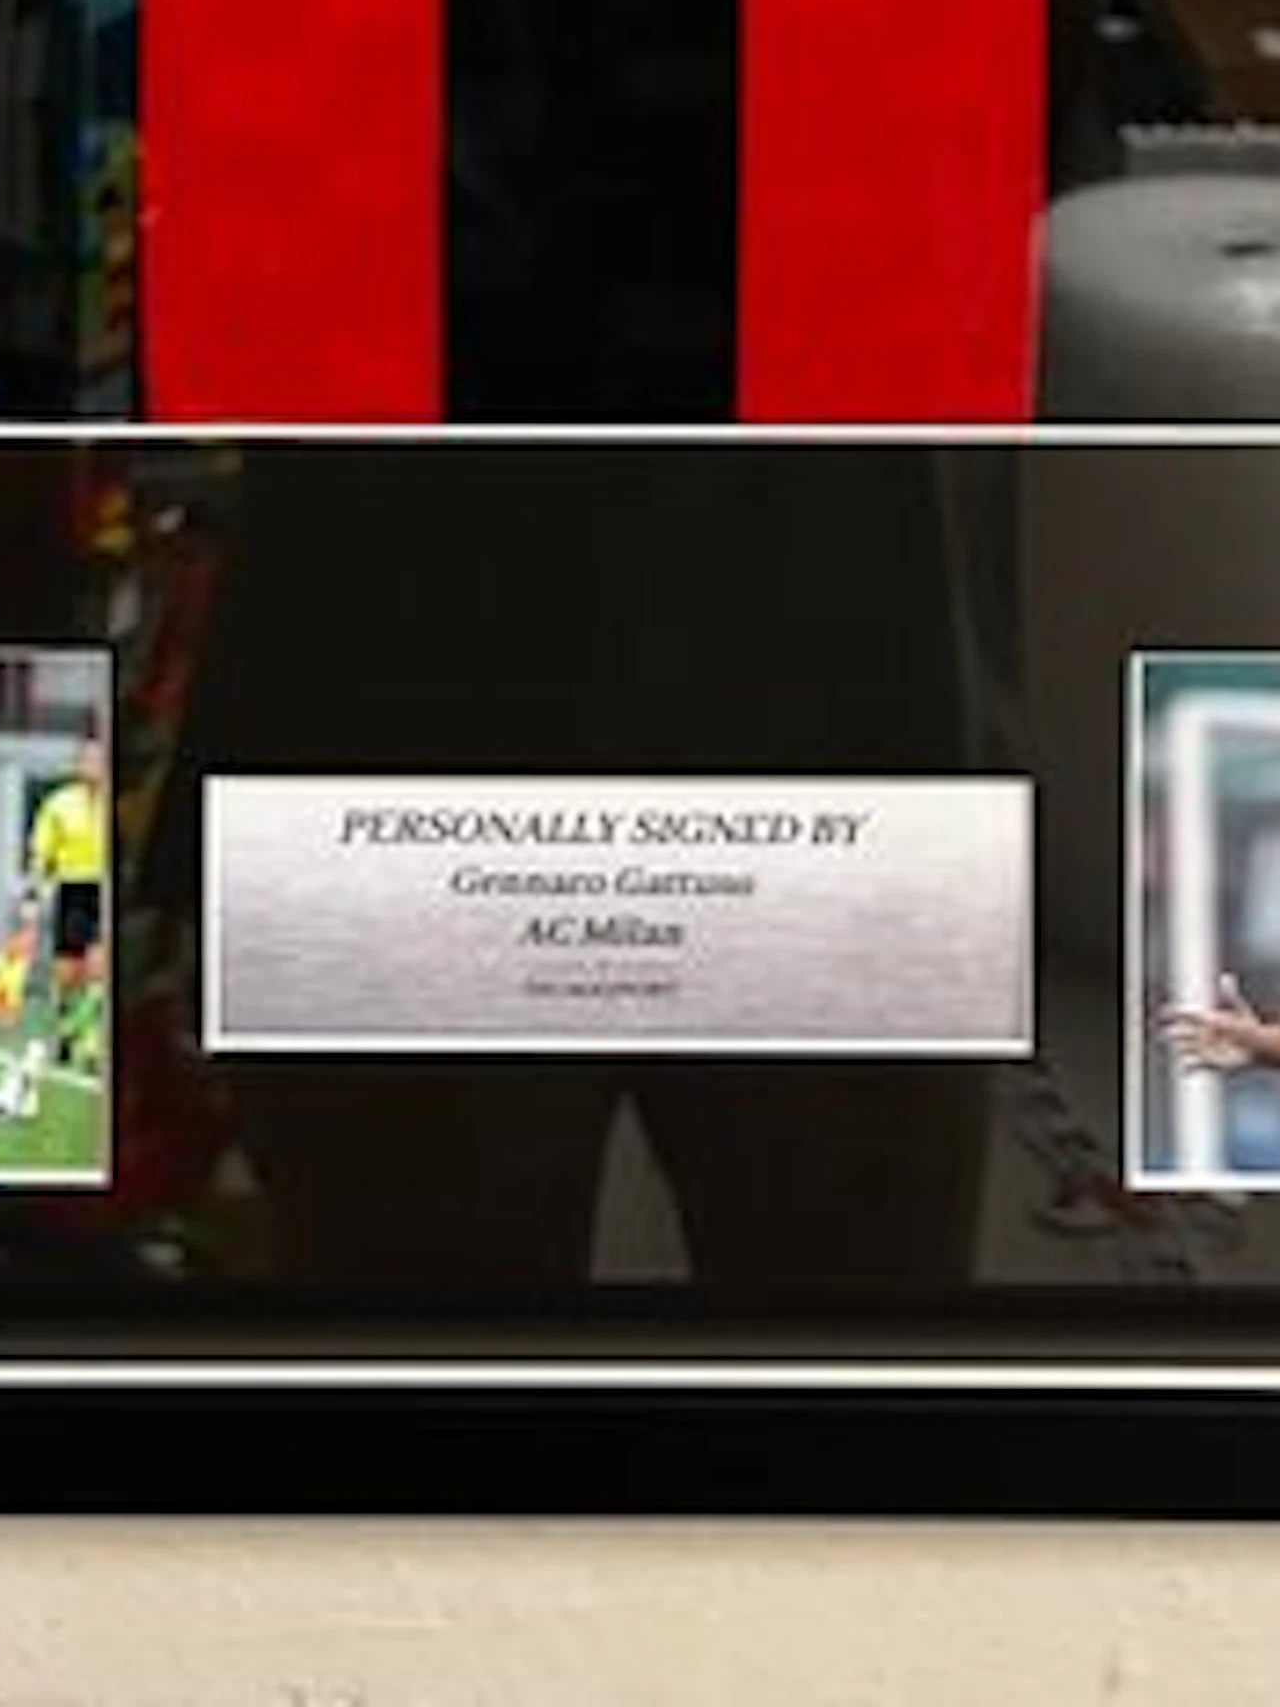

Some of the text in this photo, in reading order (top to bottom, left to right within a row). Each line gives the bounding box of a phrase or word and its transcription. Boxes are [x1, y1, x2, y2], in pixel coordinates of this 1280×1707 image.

[337, 808, 871, 845] PERSONALLY SIGNED BY
[449, 864, 609, 896] Gennaro
[520, 914, 686, 947] AC Milan
